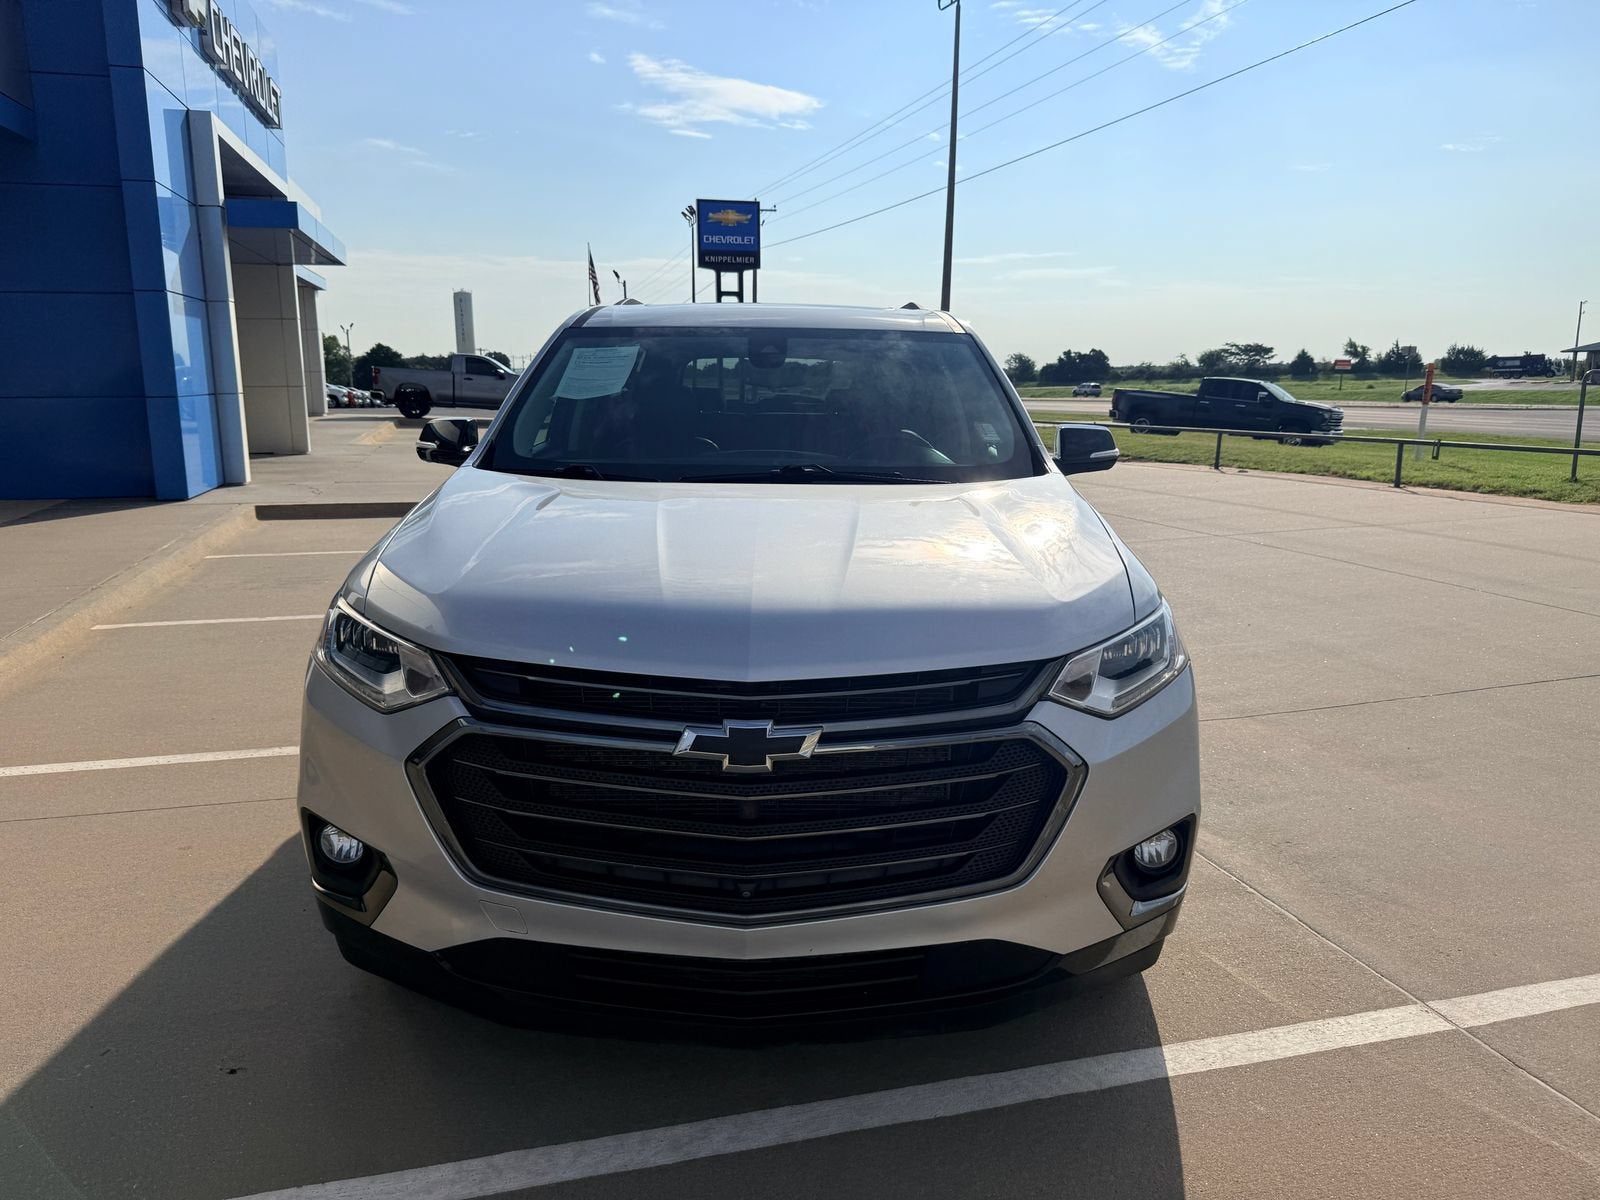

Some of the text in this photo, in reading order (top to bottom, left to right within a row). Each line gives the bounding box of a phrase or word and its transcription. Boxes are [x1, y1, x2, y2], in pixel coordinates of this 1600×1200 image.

[209, 0, 282, 128] CHEVROLET
[703, 235, 755, 244] CHEVROLET
[704, 255, 755, 264] KNIPPELMIER
